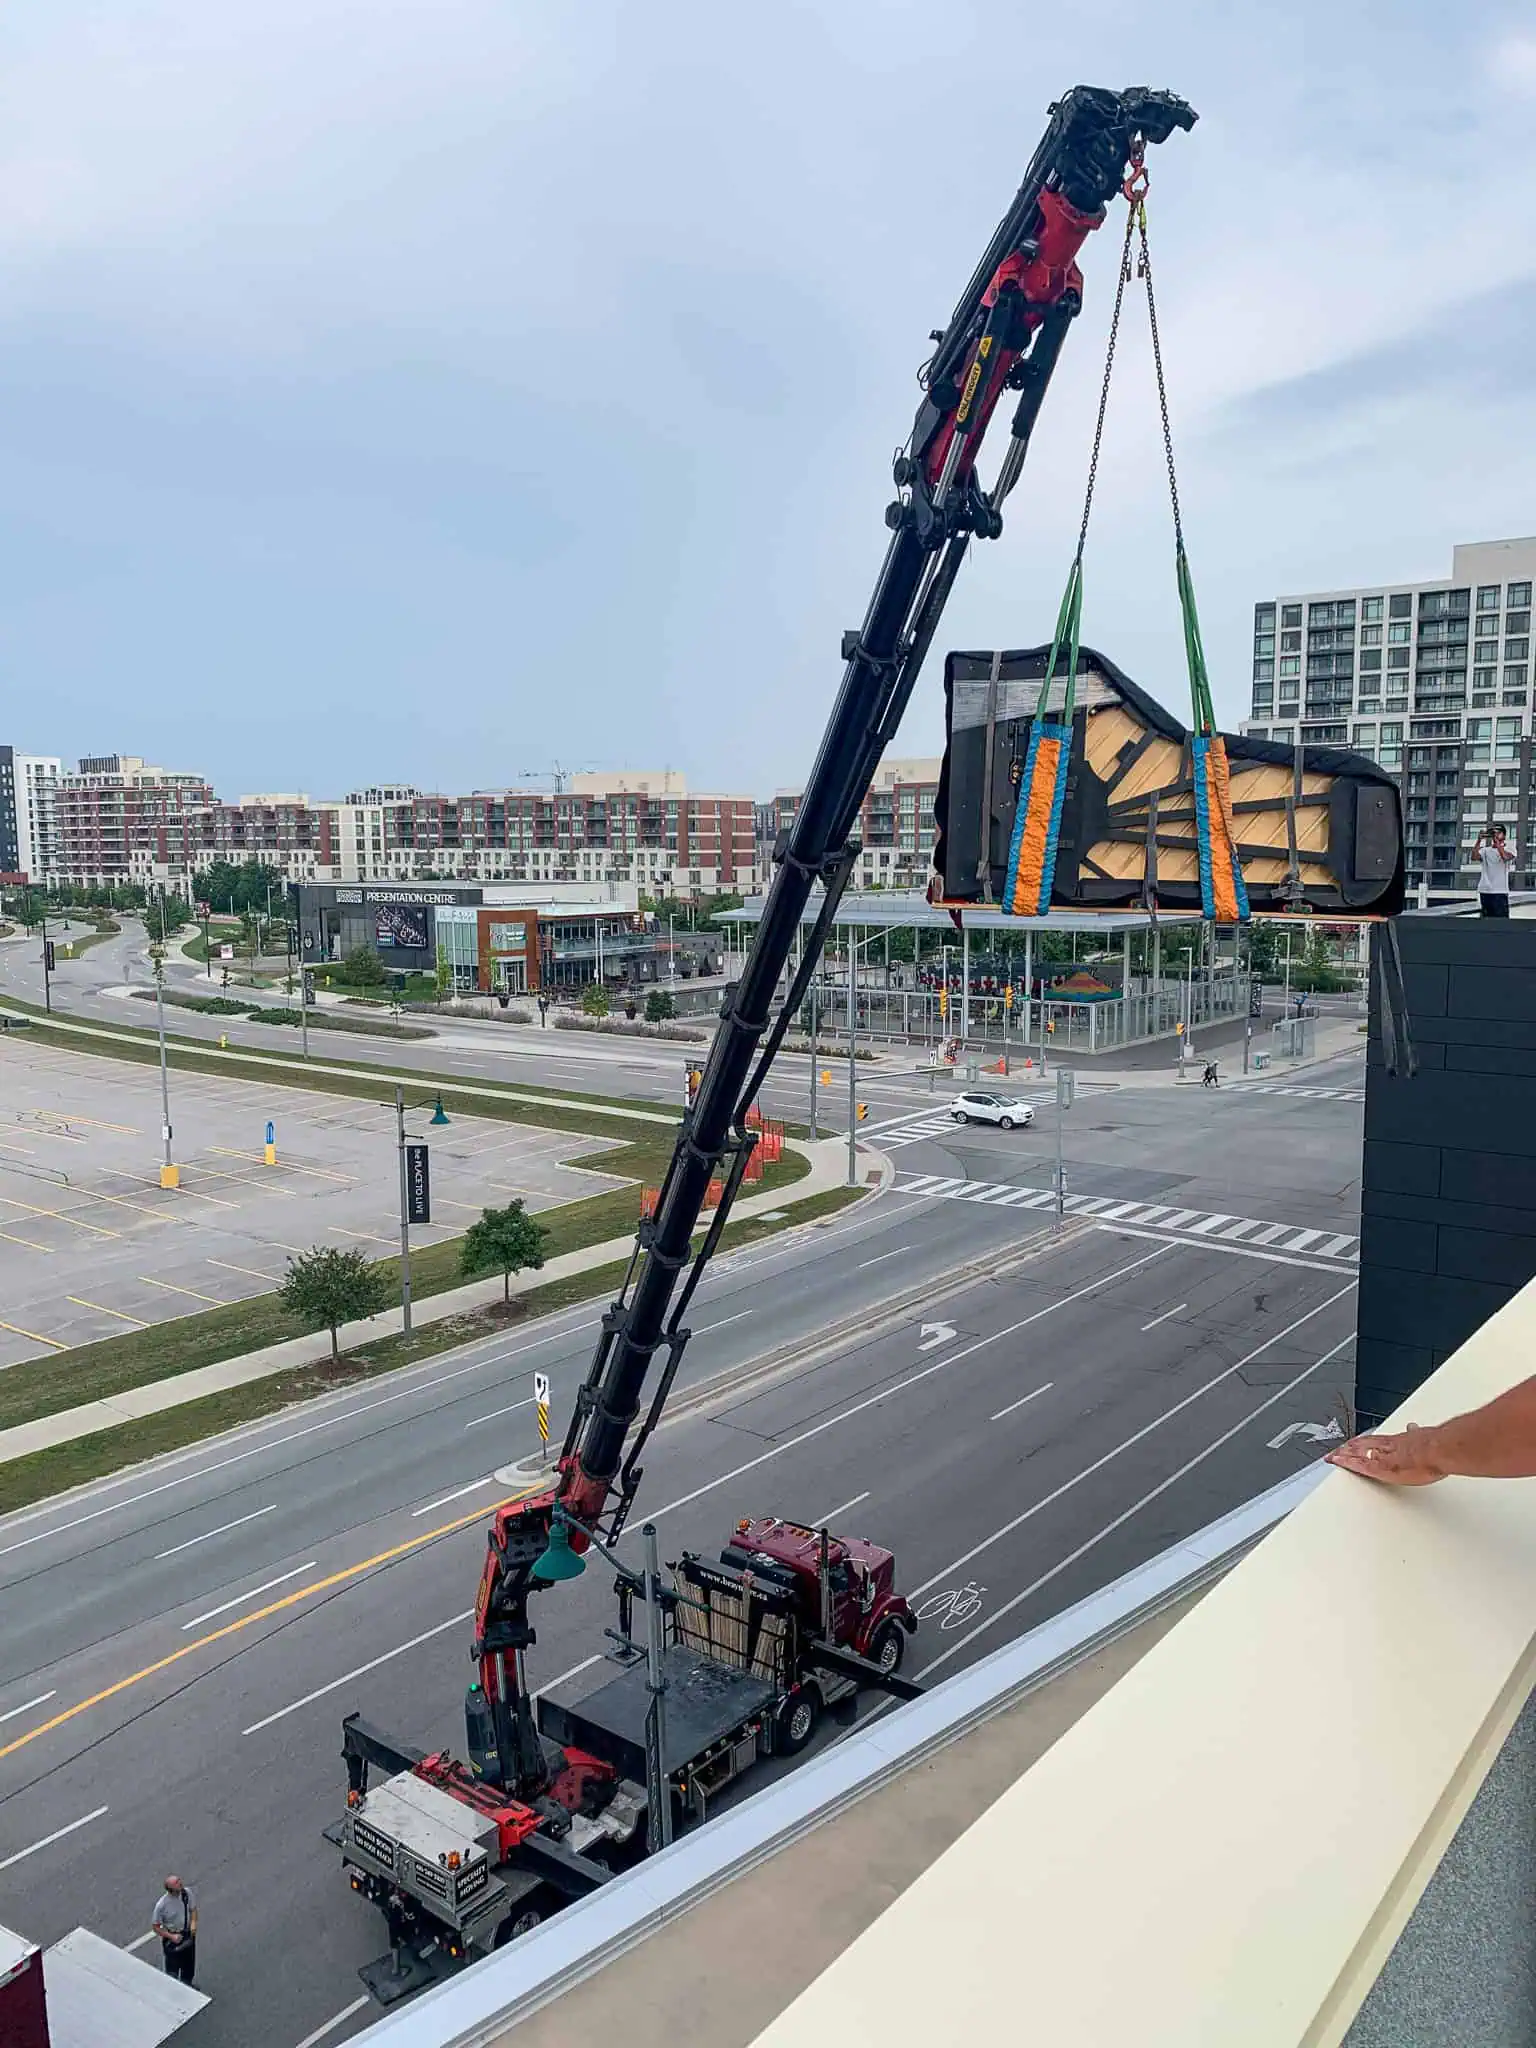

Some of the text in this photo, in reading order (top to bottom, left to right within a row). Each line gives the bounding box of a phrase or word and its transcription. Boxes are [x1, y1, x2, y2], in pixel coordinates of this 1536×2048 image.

[366, 891, 423, 904] PRESENTATION
[424, 893, 457, 904] CENTRE
[415, 1183, 424, 1195] TO
[415, 1196, 424, 1215] LIVE
[457, 1864, 486, 1889] SPECIALTY
[459, 1875, 485, 1898] MOVING
